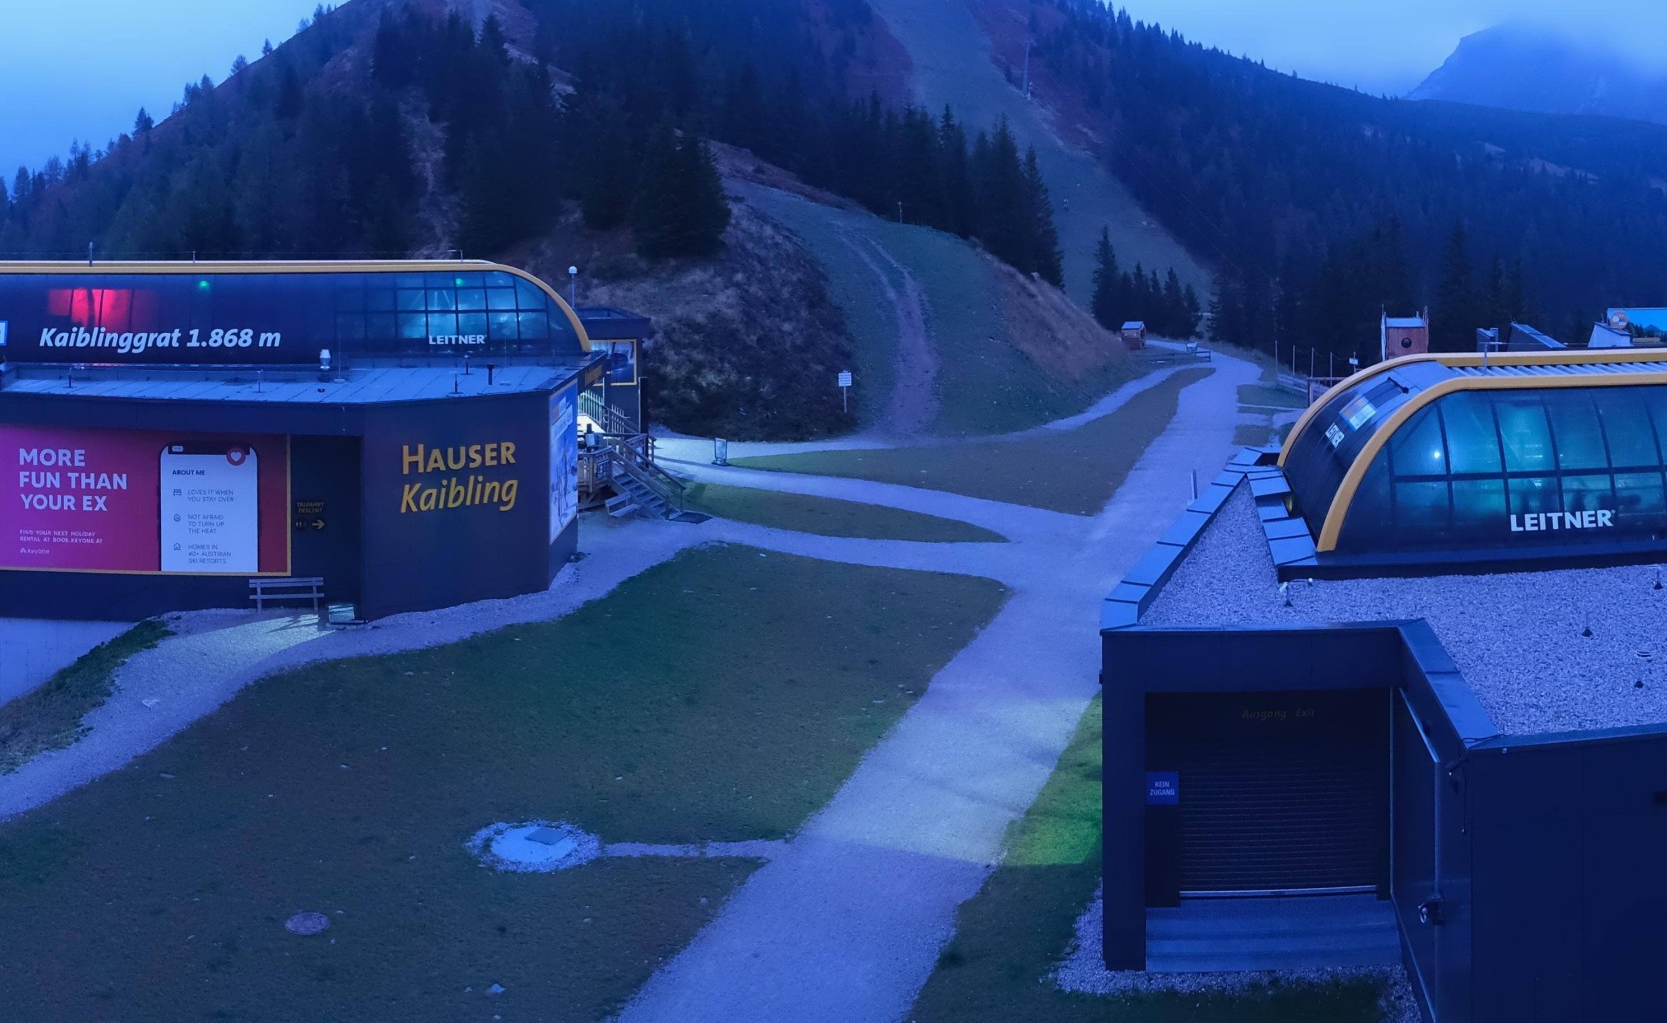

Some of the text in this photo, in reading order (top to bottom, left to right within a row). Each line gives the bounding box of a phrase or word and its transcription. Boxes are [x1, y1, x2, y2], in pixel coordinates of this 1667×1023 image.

[38, 327, 281, 353] Kaiblinggrat 1.868 m
[428, 335, 485, 345] LEITNER
[19, 448, 86, 467] MORE
[402, 441, 516, 475] HAUSER
[19, 471, 128, 490] FUN THAN
[20, 494, 108, 511] YOUR EX
[400, 475, 519, 514] Kaibling
[1510, 509, 1613, 532] LEITNER
[1242, 709, 1287, 721] Ausgang
[1149, 788, 1175, 796] ZUGANG
